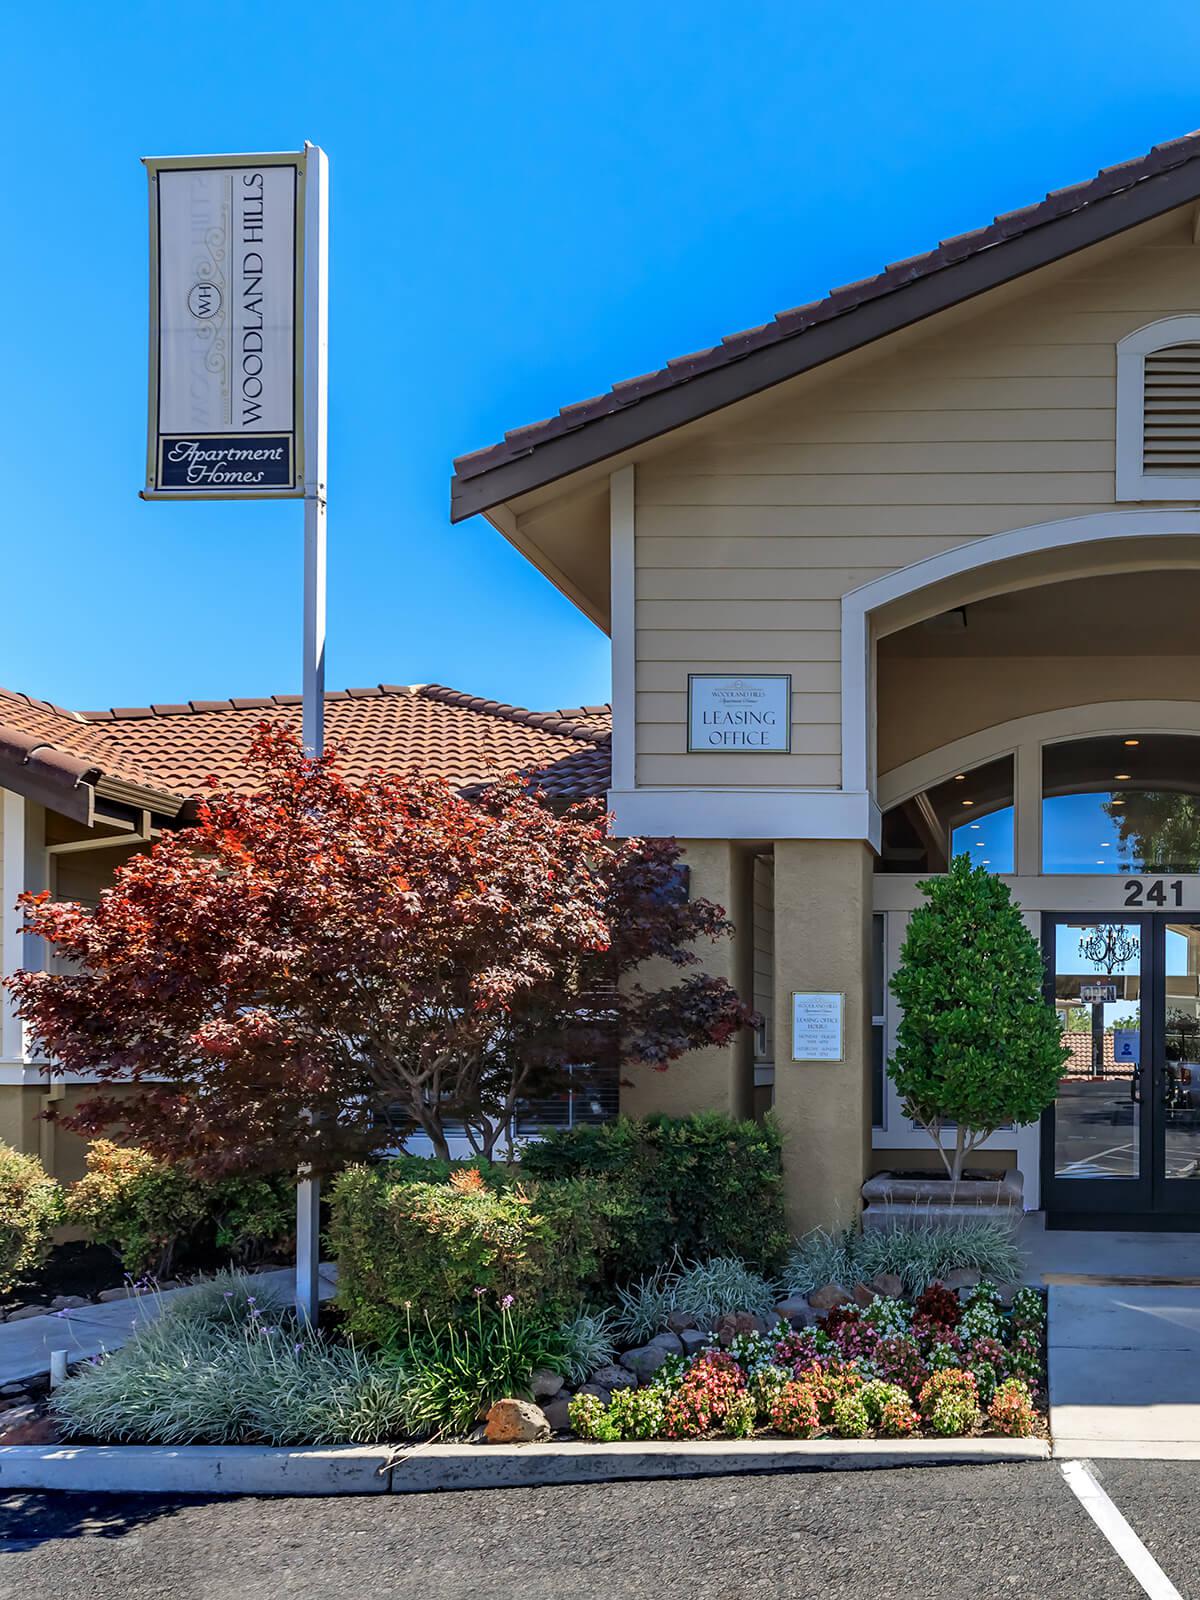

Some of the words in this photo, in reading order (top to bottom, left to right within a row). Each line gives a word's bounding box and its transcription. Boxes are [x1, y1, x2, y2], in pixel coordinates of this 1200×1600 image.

[242, 173, 264, 243] HILLS
[198, 285, 212, 315] WH
[242, 252, 264, 426] WOODLAND
[167, 441, 284, 471] Apartment
[186, 462, 264, 484] Homes
[703, 710, 776, 725] LEASING
[708, 730, 770, 745] OFFICE
[1124, 879, 1183, 907] 241
[1082, 986, 1115, 1001] OPEN
